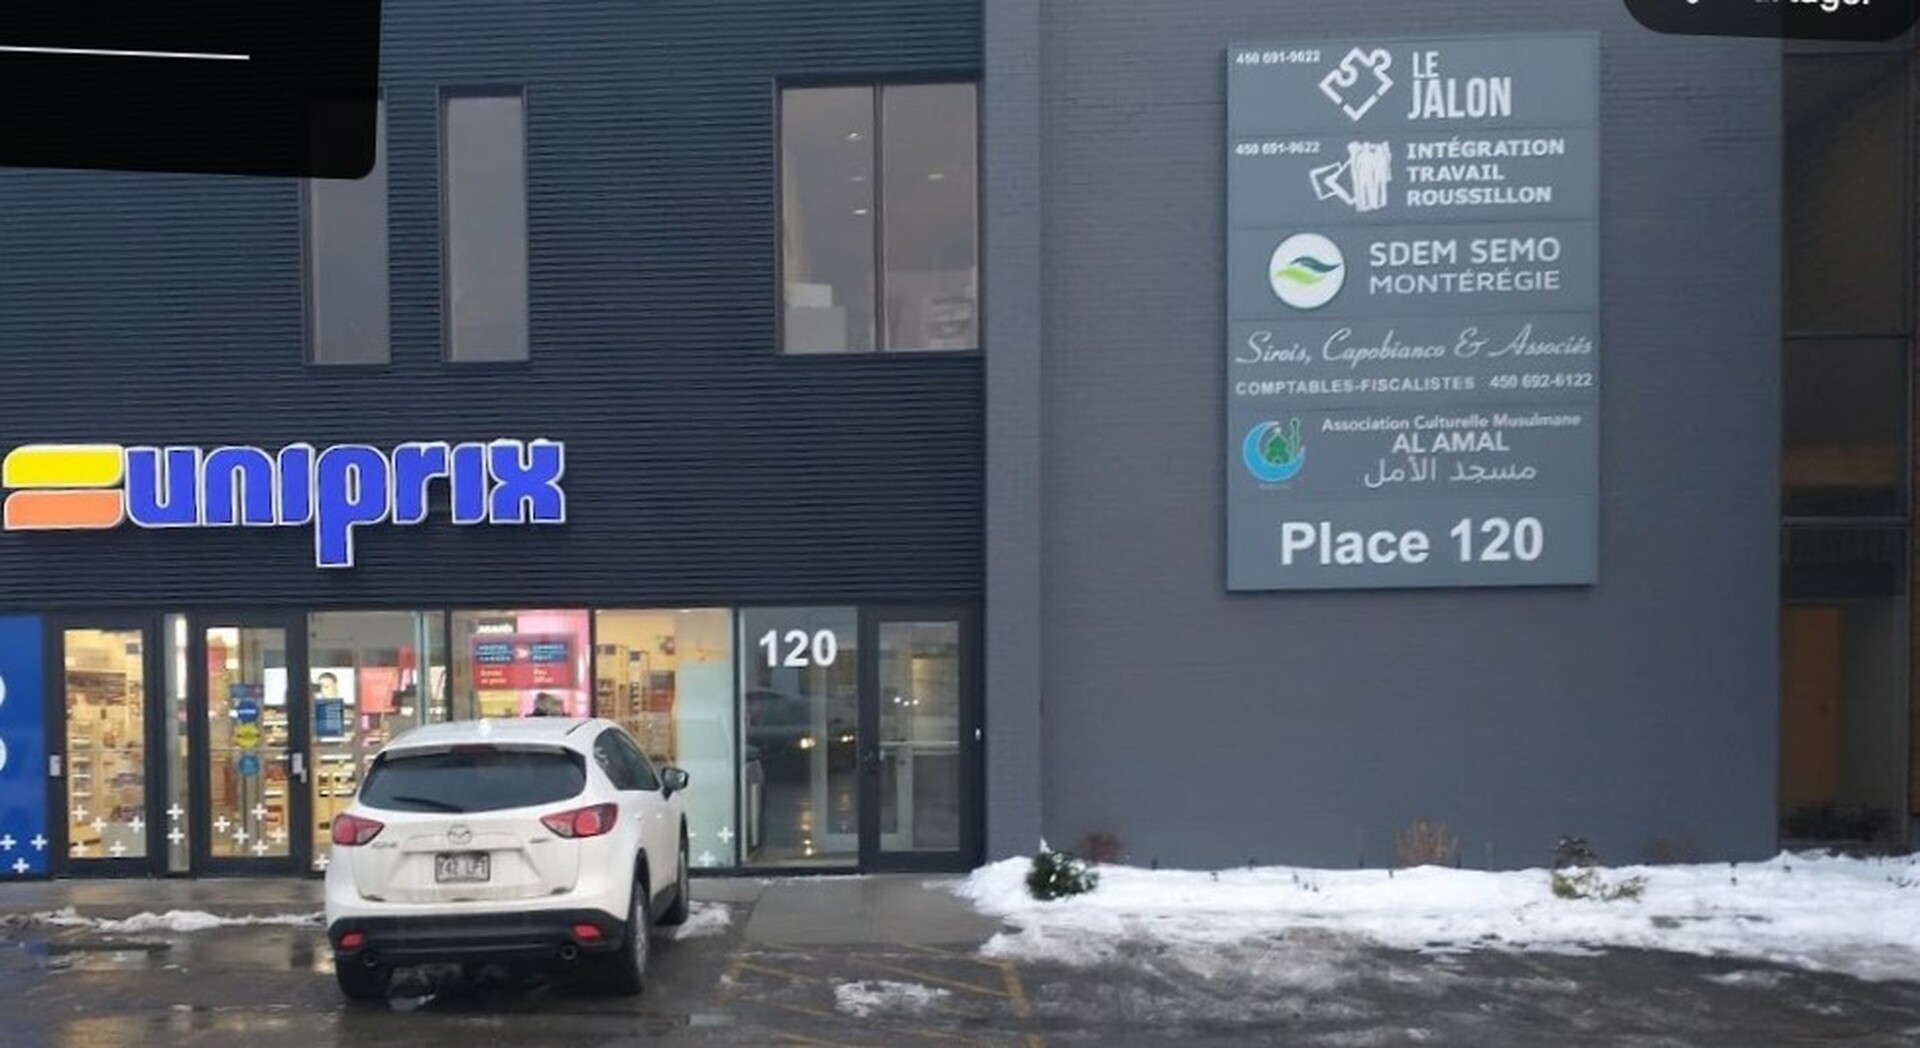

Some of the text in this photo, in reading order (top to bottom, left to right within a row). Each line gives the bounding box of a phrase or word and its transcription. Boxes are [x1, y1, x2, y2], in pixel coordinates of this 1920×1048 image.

[1236, 51, 1260, 64] 450
[1413, 51, 1439, 78] LE
[1407, 77, 1512, 119] JALON
[1407, 136, 1565, 159] INTÉGRATION
[1407, 165, 1505, 182] TRAVAIL
[1407, 187, 1552, 206] ROUSSILLON
[1369, 237, 1561, 266] SDEM SEMO
[1369, 269, 1560, 295] MONTÉRÉGIE
[1235, 330, 1312, 365] Sirois,
[1322, 327, 1446, 369] Capobianco
[1453, 326, 1490, 358] &
[1235, 372, 1593, 396] COMPTABLES-FISCALISTES 450 692-6122
[1321, 412, 1582, 432] Association Culturelle Musulmane
[1391, 430, 1511, 454] AL AMAL
[1364, 455, 1538, 489] مسجد الأمل
[124, 440, 567, 569] uniprix
[1280, 516, 1545, 566] Place 120
[758, 629, 838, 667] 120
